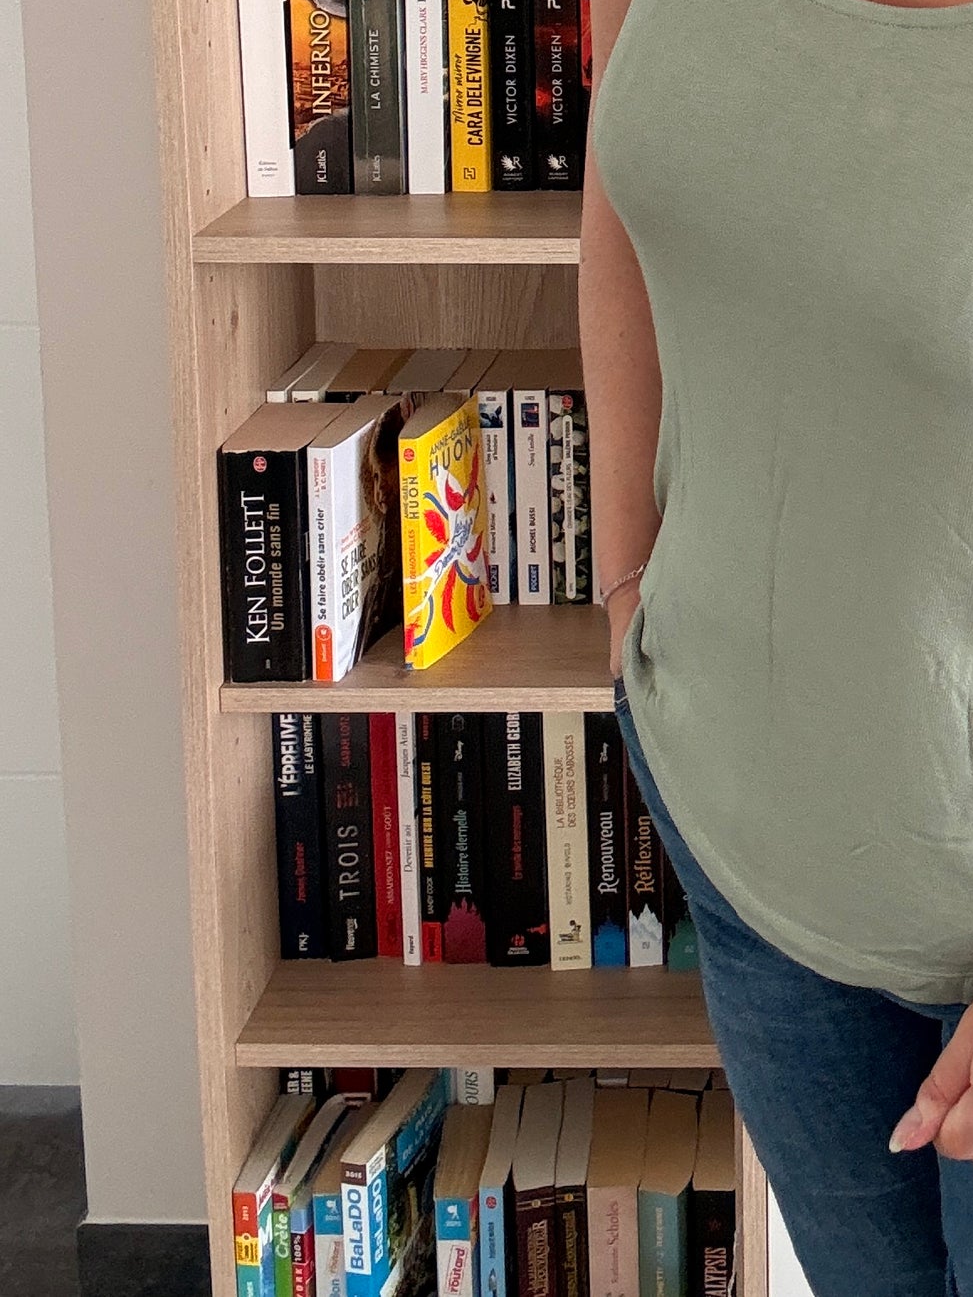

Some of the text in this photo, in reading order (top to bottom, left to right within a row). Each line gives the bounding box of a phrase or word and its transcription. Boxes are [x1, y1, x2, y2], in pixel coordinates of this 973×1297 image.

[310, 10, 331, 114] INFERNO
[369, 30, 381, 109] LA CHIMISTE
[419, 7, 428, 93] MARY HIGGINS CLARK
[466, 28, 483, 145] CARA DELEVINGNE
[505, 35, 517, 124] VICTOR DIXEN
[551, 35, 563, 124] VICTOR DIXEN
[409, 476, 419, 519] HUON
[430, 434, 473, 480] HUON
[241, 491, 270, 643] KEN FOLLETT
[266, 503, 284, 630] Un monde sans fin
[315, 508, 326, 620] Se faire obéir sans crier
[529, 565, 539, 592] POCKET
[278, 714, 301, 796] L'ÉPREUVE
[304, 715, 314, 773] LE LABYRINTHE
[399, 724, 409, 777] Jacques Attali
[337, 825, 360, 900] TROIS
[452, 810, 473, 893] Histoire éternelle
[598, 812, 619, 893] Renouveau
[634, 816, 654, 893] Réflexion
[275, 1214, 289, 1258] Crète
[347, 1189, 363, 1270] BaLaDO
[449, 1248, 465, 1293] routard
